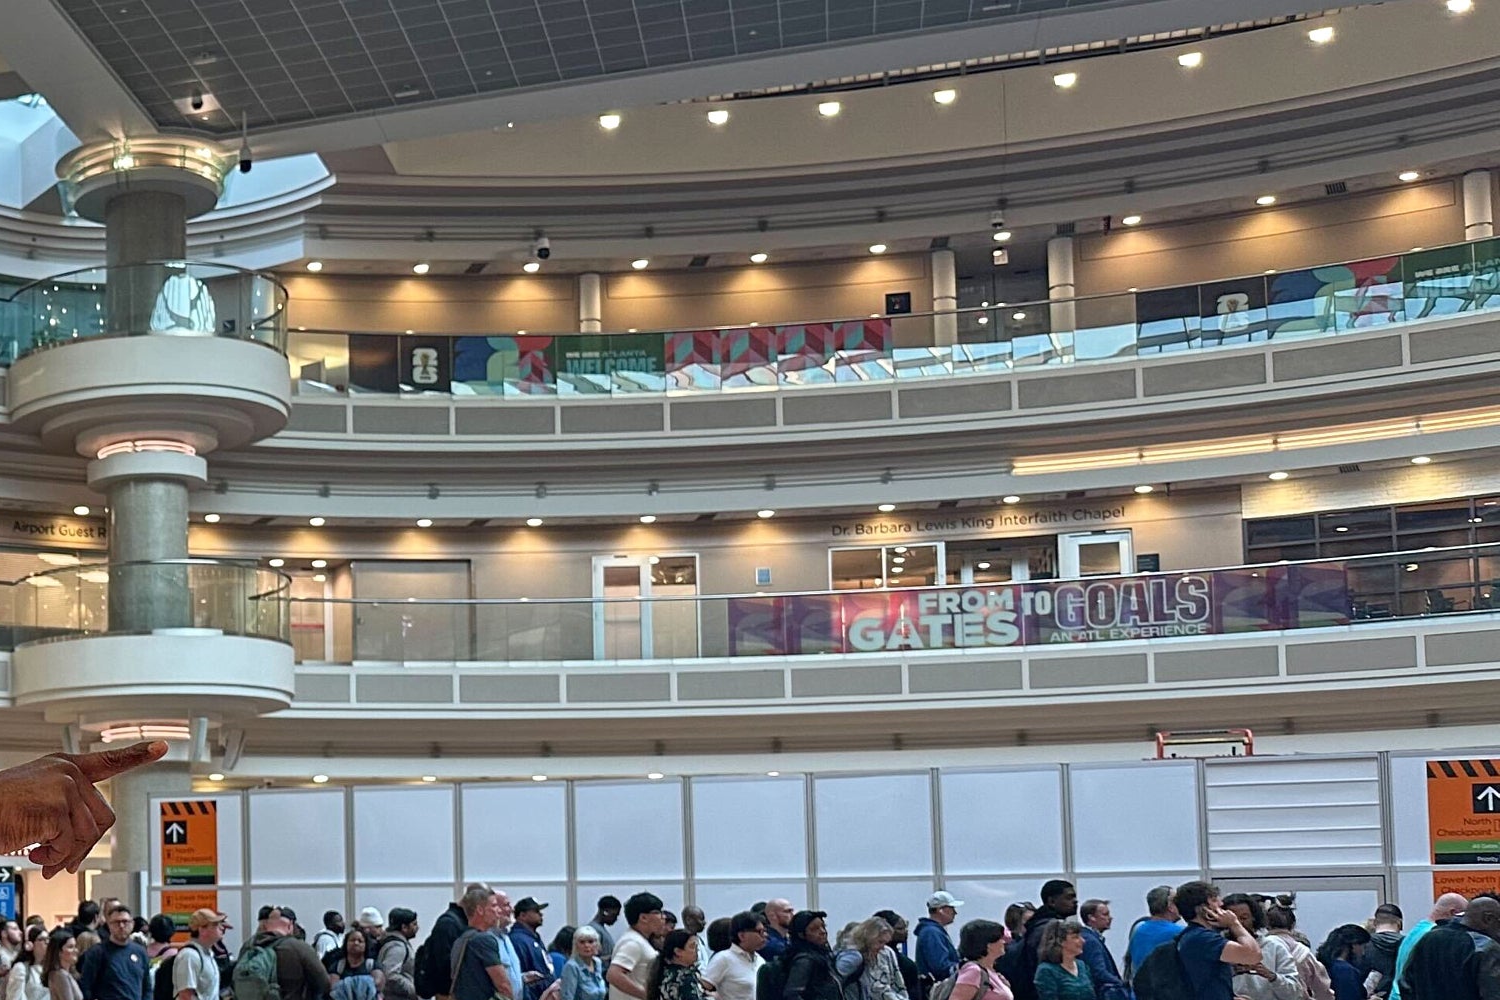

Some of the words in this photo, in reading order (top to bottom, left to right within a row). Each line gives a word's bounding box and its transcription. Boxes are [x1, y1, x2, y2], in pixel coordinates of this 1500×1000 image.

[13, 520, 56, 534] Airport
[59, 525, 95, 538] Guest
[832, 524, 850, 537] Dr.
[855, 522, 912, 536] Barbara
[916, 518, 957, 532] Lewis
[961, 516, 995, 530] King
[999, 510, 1068, 527] Interfaith
[1073, 506, 1126, 522] Chapel
[918, 588, 1013, 616] FROM
[1021, 590, 1050, 616] TO
[1054, 576, 1211, 631] GOALS
[850, 610, 1020, 651] GATES
[1050, 631, 1077, 644] AN
[1078, 629, 1105, 642] ATL
[1108, 623, 1208, 640] EXPERIENCE
[1437, 828, 1492, 837] Checkpoint
[1435, 876, 1465, 884] Lower
[1468, 875, 1496, 884] North
